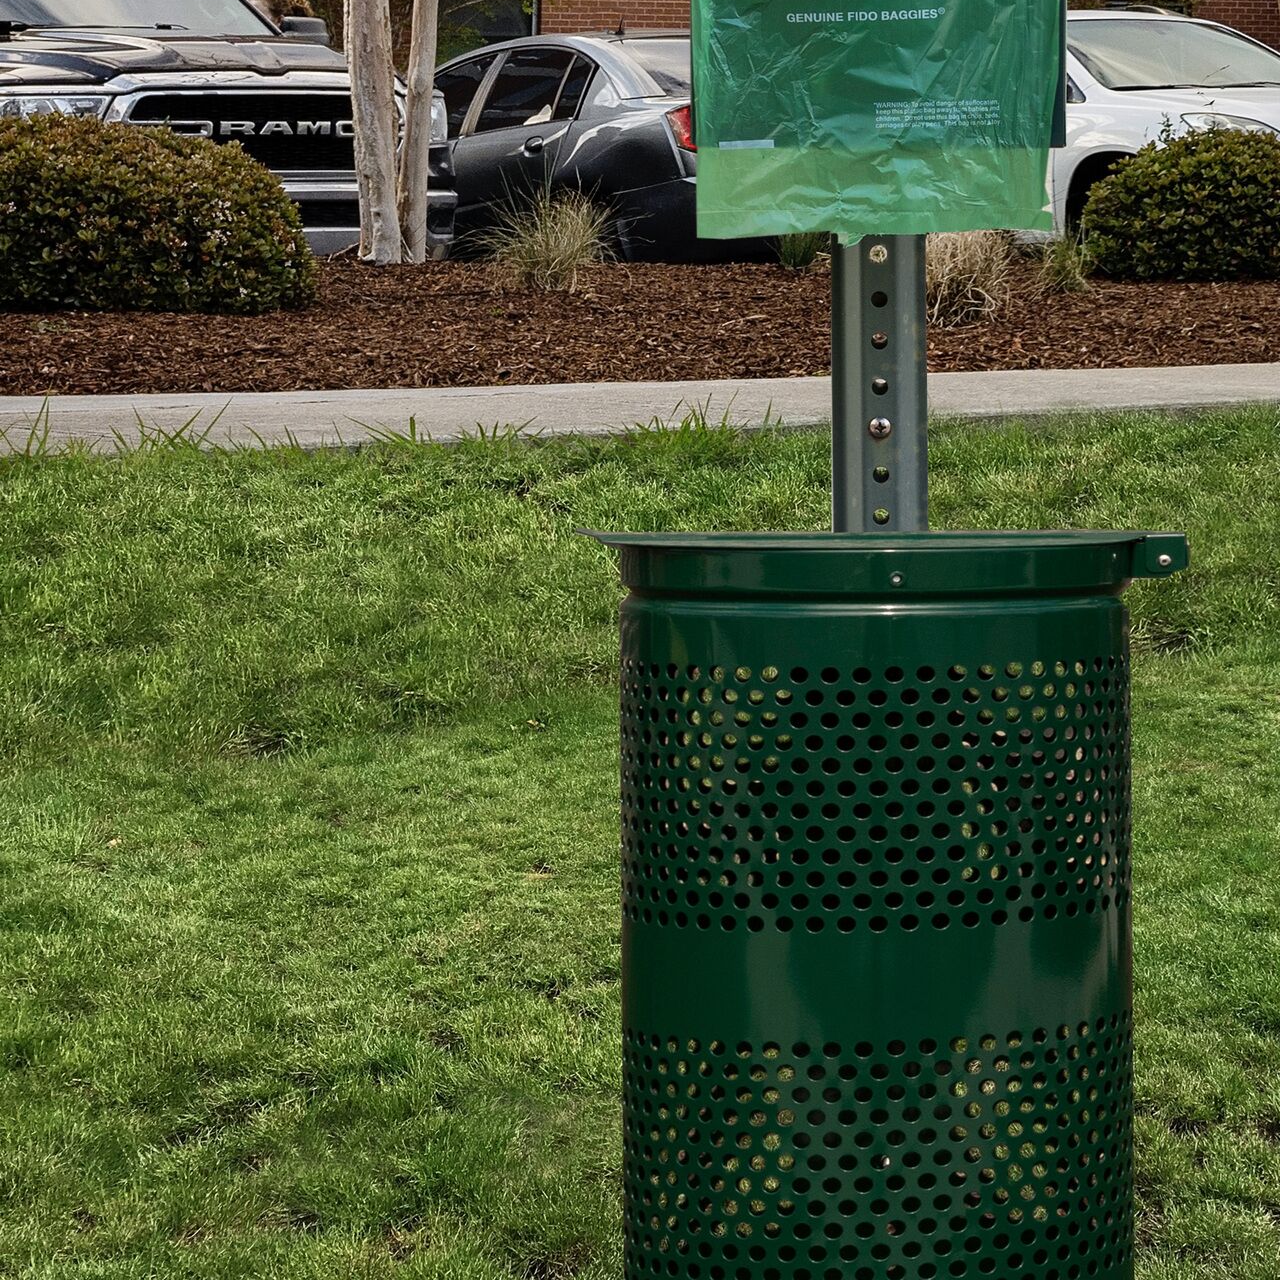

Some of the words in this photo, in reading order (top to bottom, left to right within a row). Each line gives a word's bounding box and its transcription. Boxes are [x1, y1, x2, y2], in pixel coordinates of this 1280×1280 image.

[786, 12, 844, 23] GENUINE
[847, 11, 878, 22] FIDO
[219, 120, 332, 136] RAM
